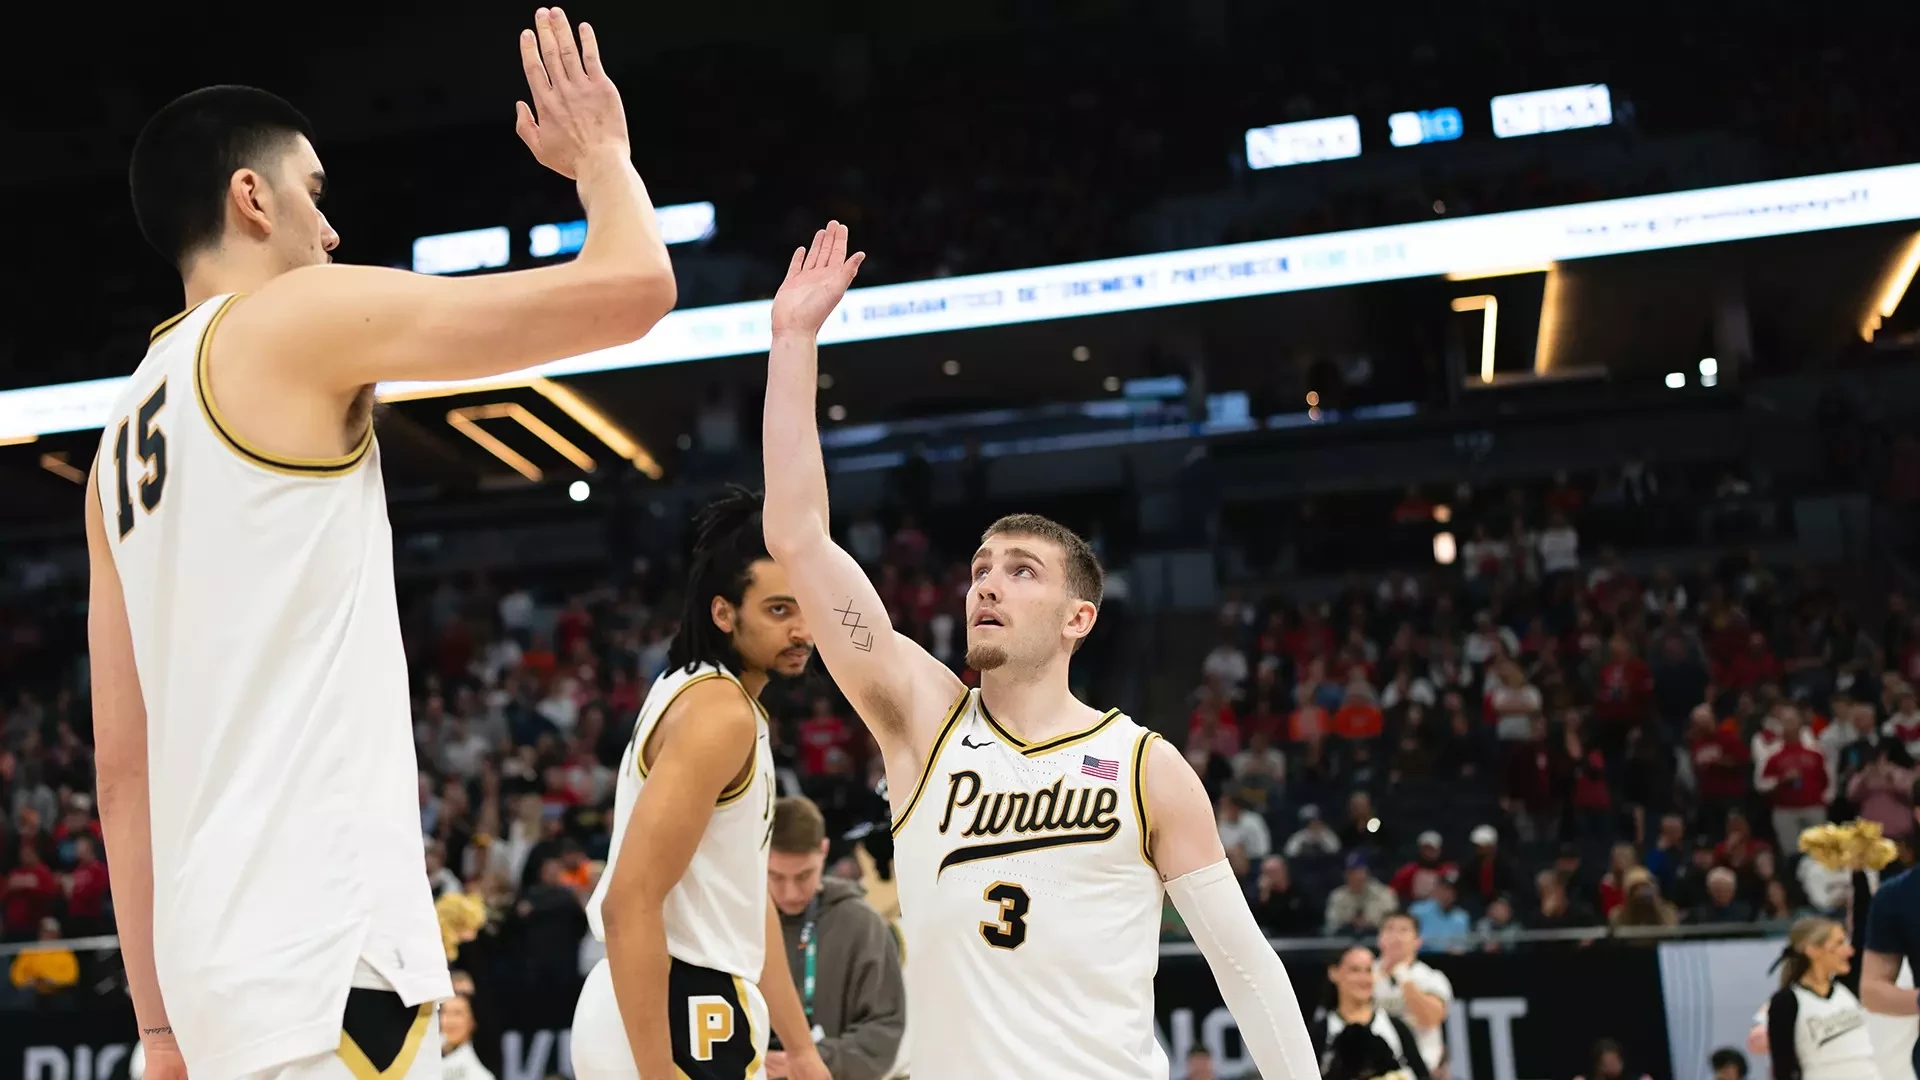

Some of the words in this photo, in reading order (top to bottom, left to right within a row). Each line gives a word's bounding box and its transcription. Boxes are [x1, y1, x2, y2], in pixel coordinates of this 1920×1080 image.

[113, 375, 168, 543] 15
[939, 769, 1122, 841] Purdue
[979, 880, 1031, 951] 3
[688, 995, 734, 1061] P
